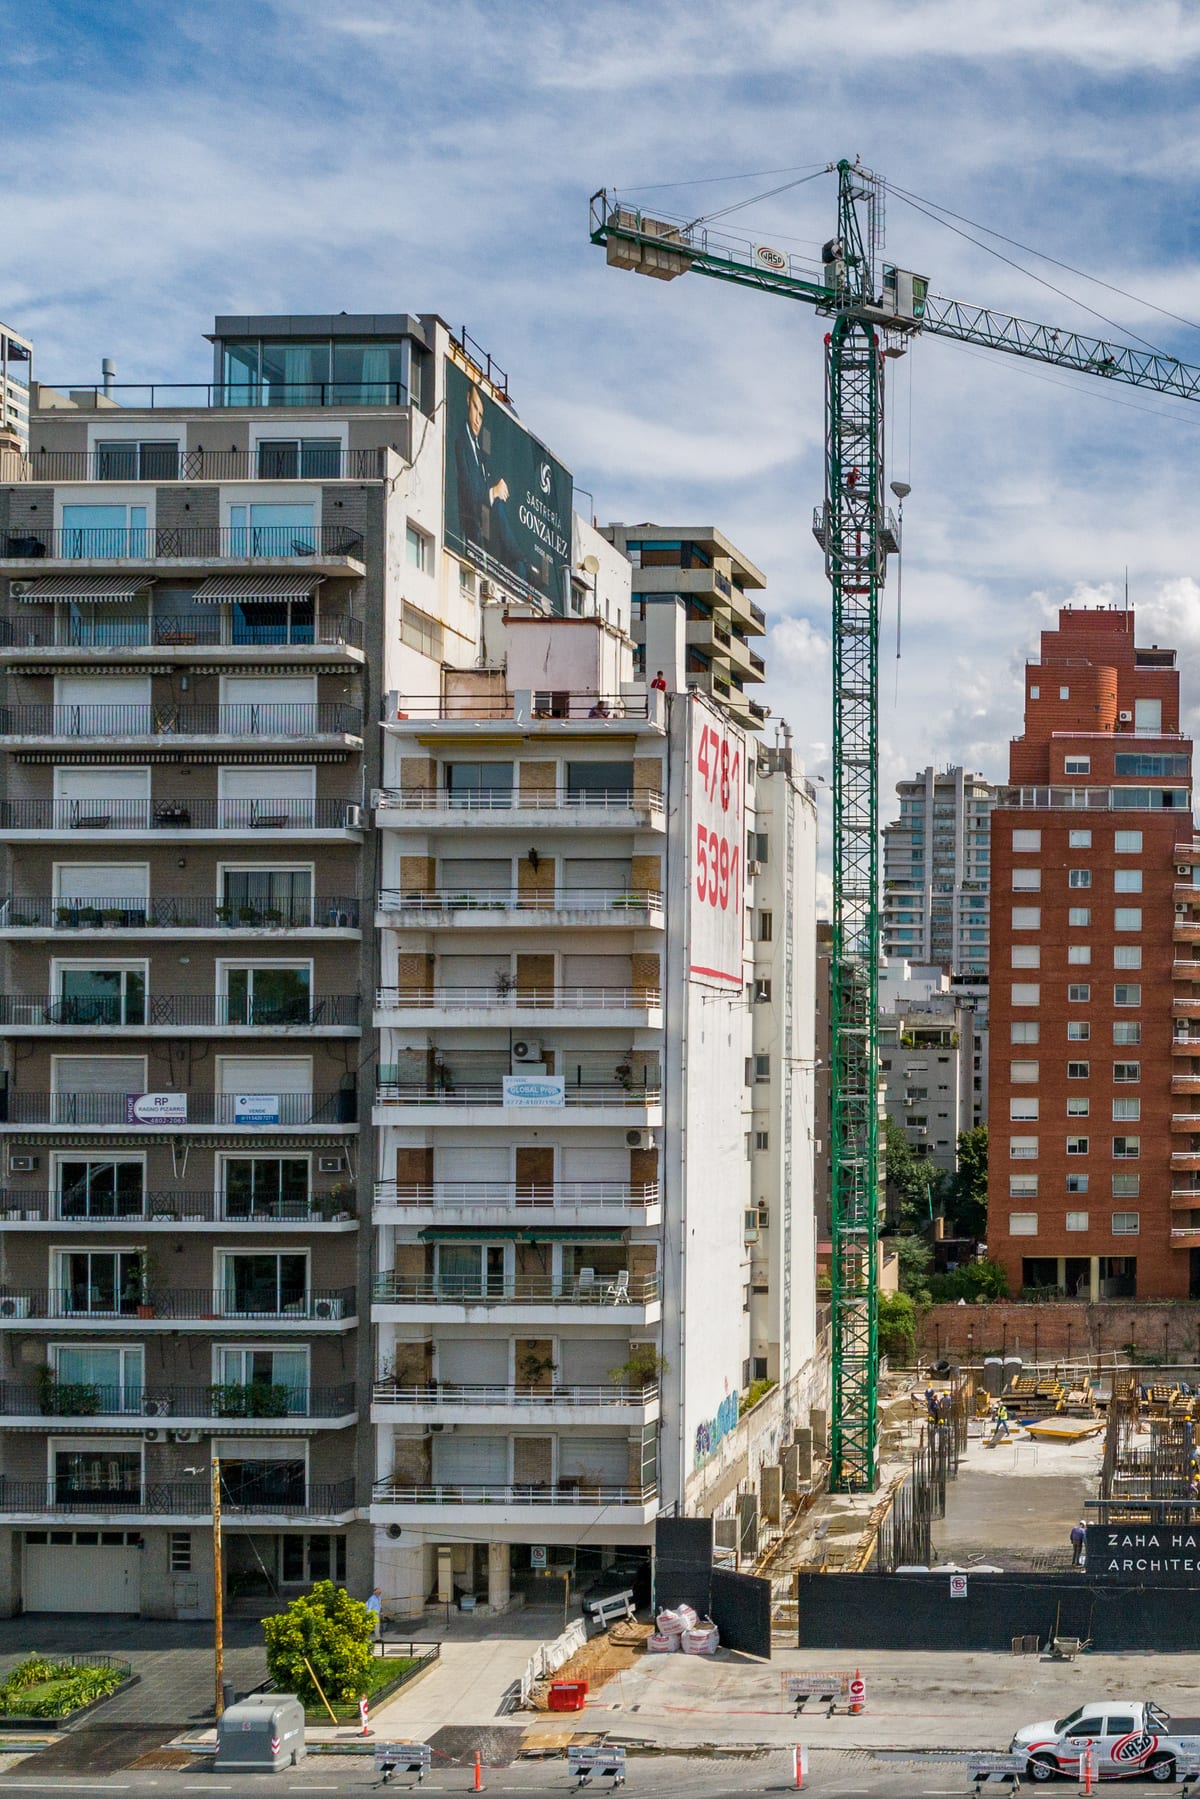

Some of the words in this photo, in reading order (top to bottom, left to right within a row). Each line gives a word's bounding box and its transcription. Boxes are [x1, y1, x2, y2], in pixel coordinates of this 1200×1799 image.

[519, 504, 568, 559] GONZALEZ
[697, 723, 740, 820] 4781
[696, 822, 740, 915] 5391
[154, 1097, 169, 1106] RP
[510, 1086, 539, 1094] GLOBAL
[1107, 1534, 1160, 1547] ZAHA
